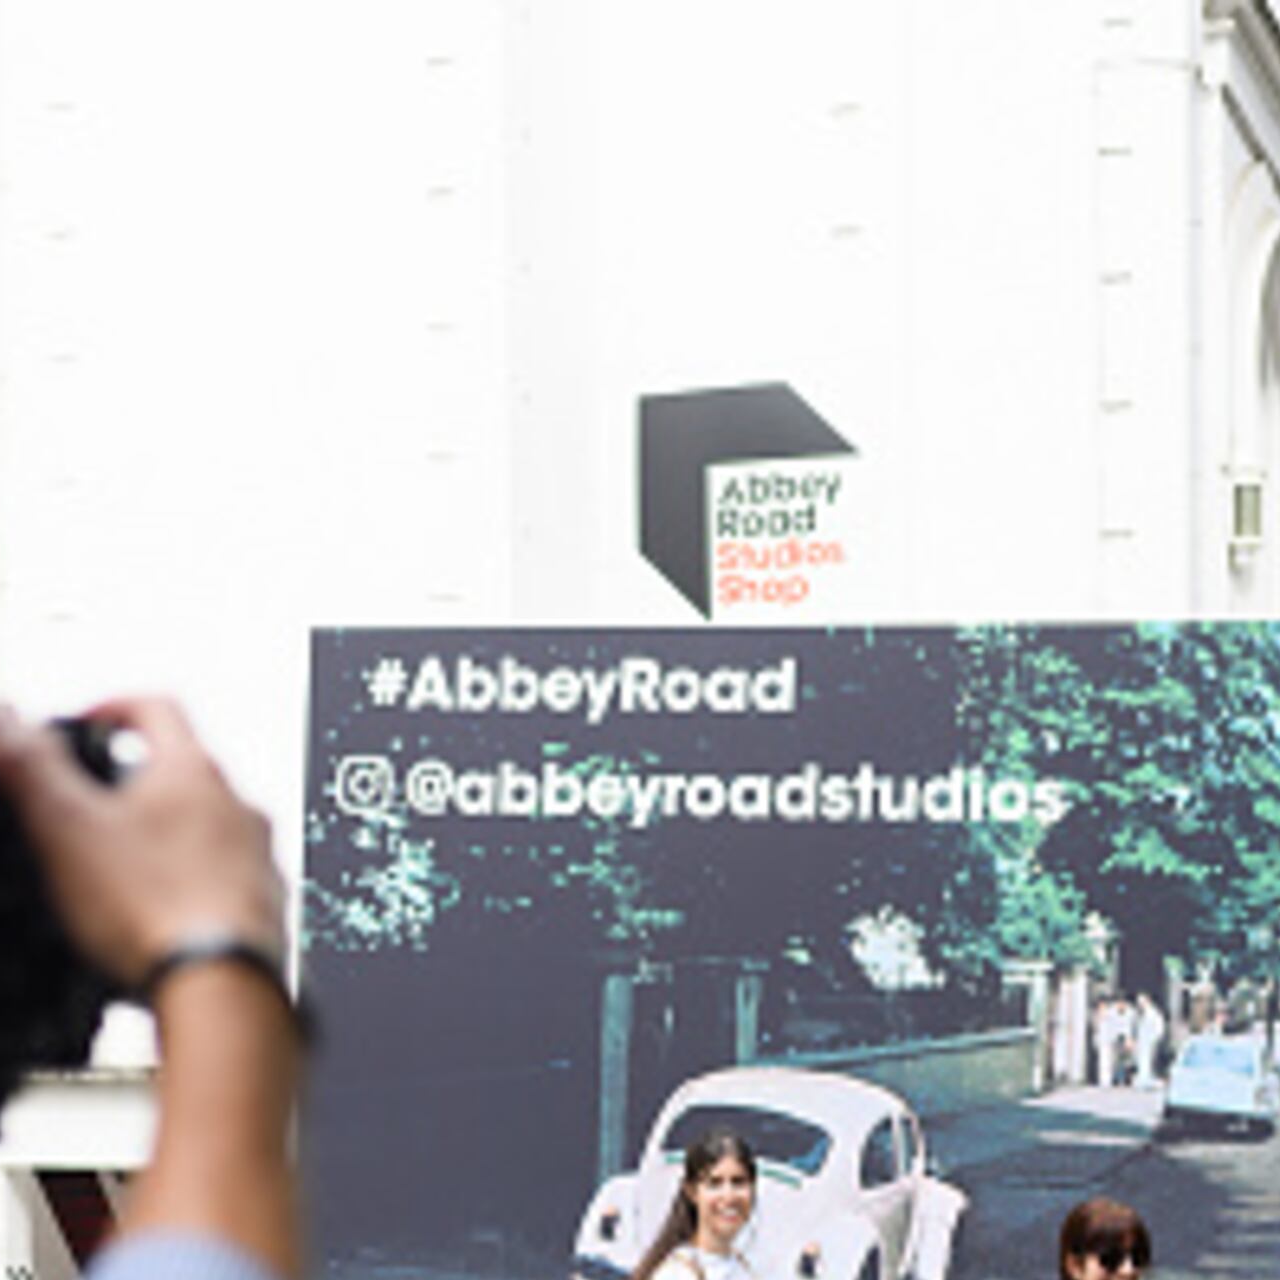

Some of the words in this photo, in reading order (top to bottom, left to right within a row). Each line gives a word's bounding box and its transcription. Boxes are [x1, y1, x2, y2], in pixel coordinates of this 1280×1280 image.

[717, 471, 842, 505] Abbey
[717, 506, 817, 537] Road
[717, 574, 811, 607] Shop
[367, 657, 798, 724] #AbbeyRoad
[406, 761, 1069, 827] @abbeyroadstudios
